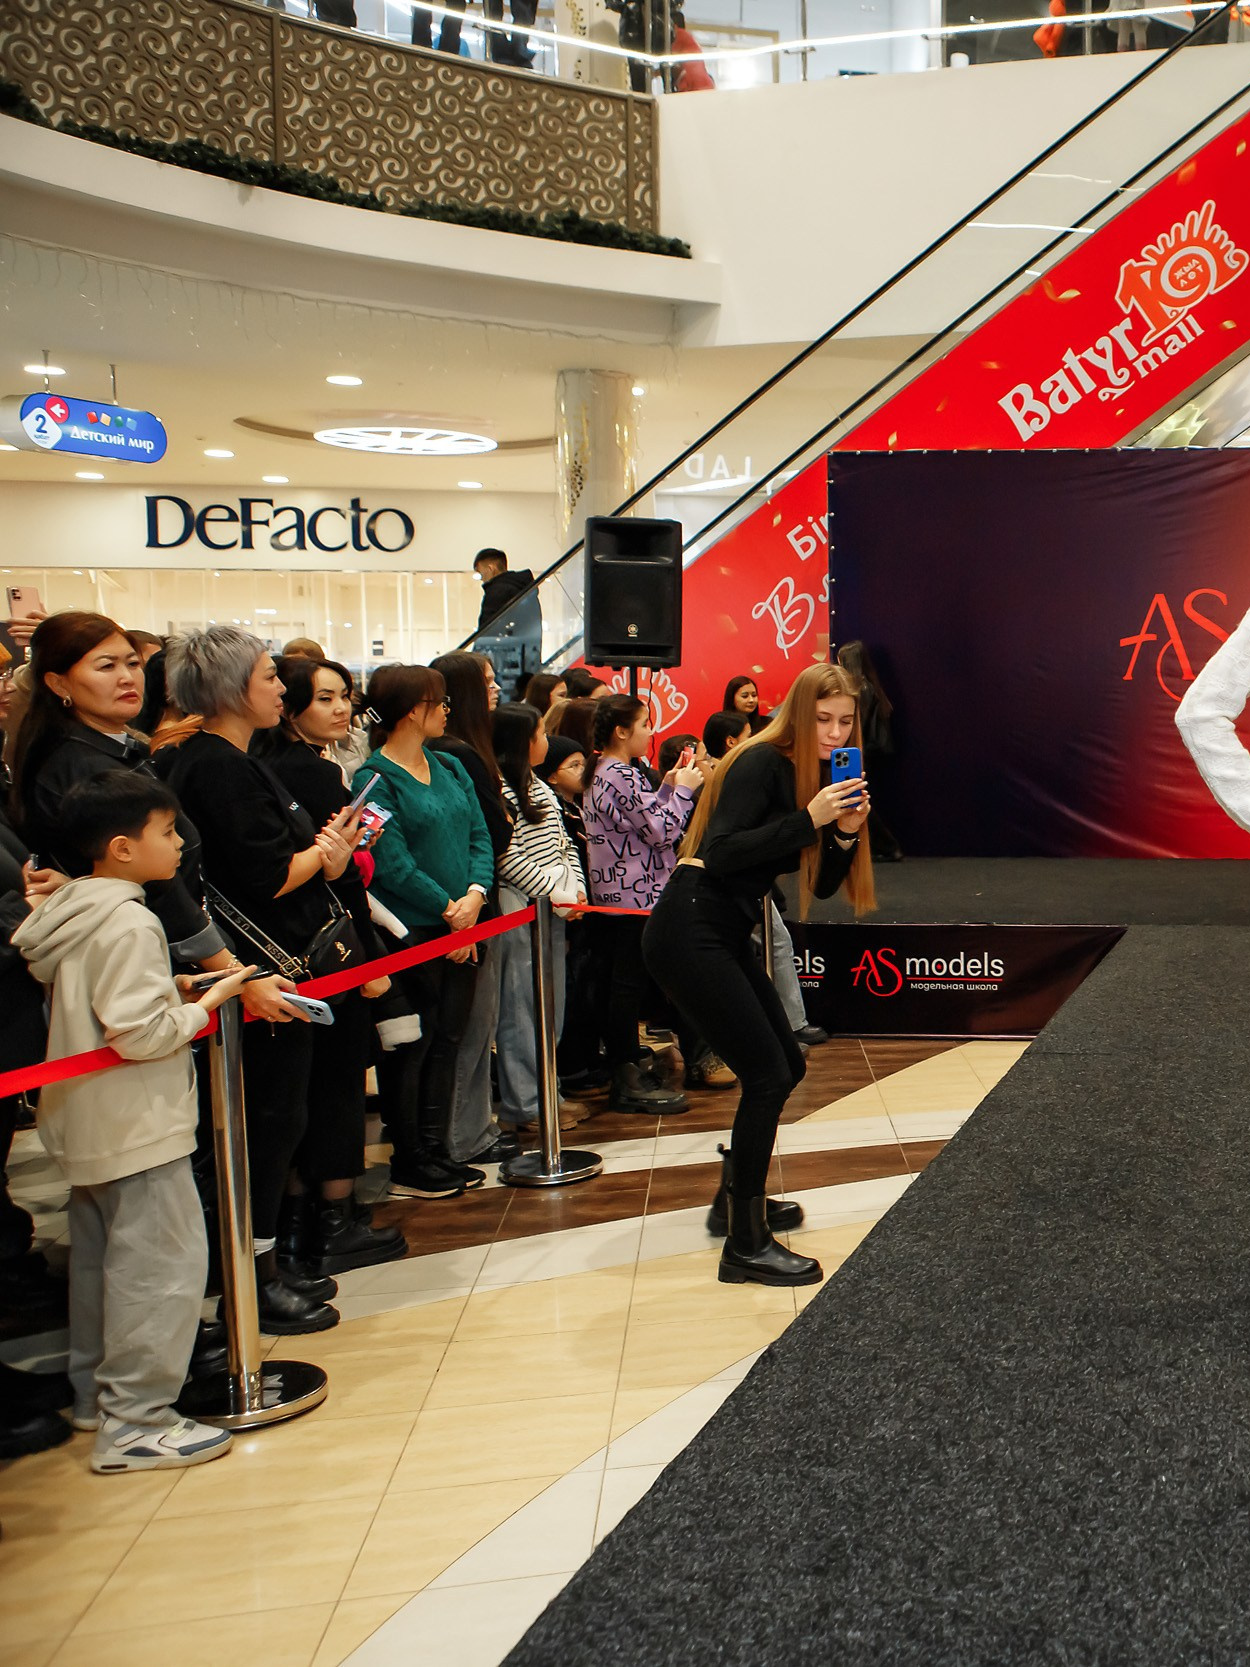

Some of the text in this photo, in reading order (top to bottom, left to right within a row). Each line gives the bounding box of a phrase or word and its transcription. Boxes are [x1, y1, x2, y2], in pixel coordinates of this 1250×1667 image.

[1133, 314, 1205, 378] mall
[997, 317, 1141, 441] Batyr
[35, 413, 48, 434] 2
[70, 426, 155, 454] Детский мир
[144, 495, 415, 552] DeFacto
[792, 949, 825, 974] els
[850, 947, 1005, 997] AS models
[910, 982, 998, 991] модельная школа
